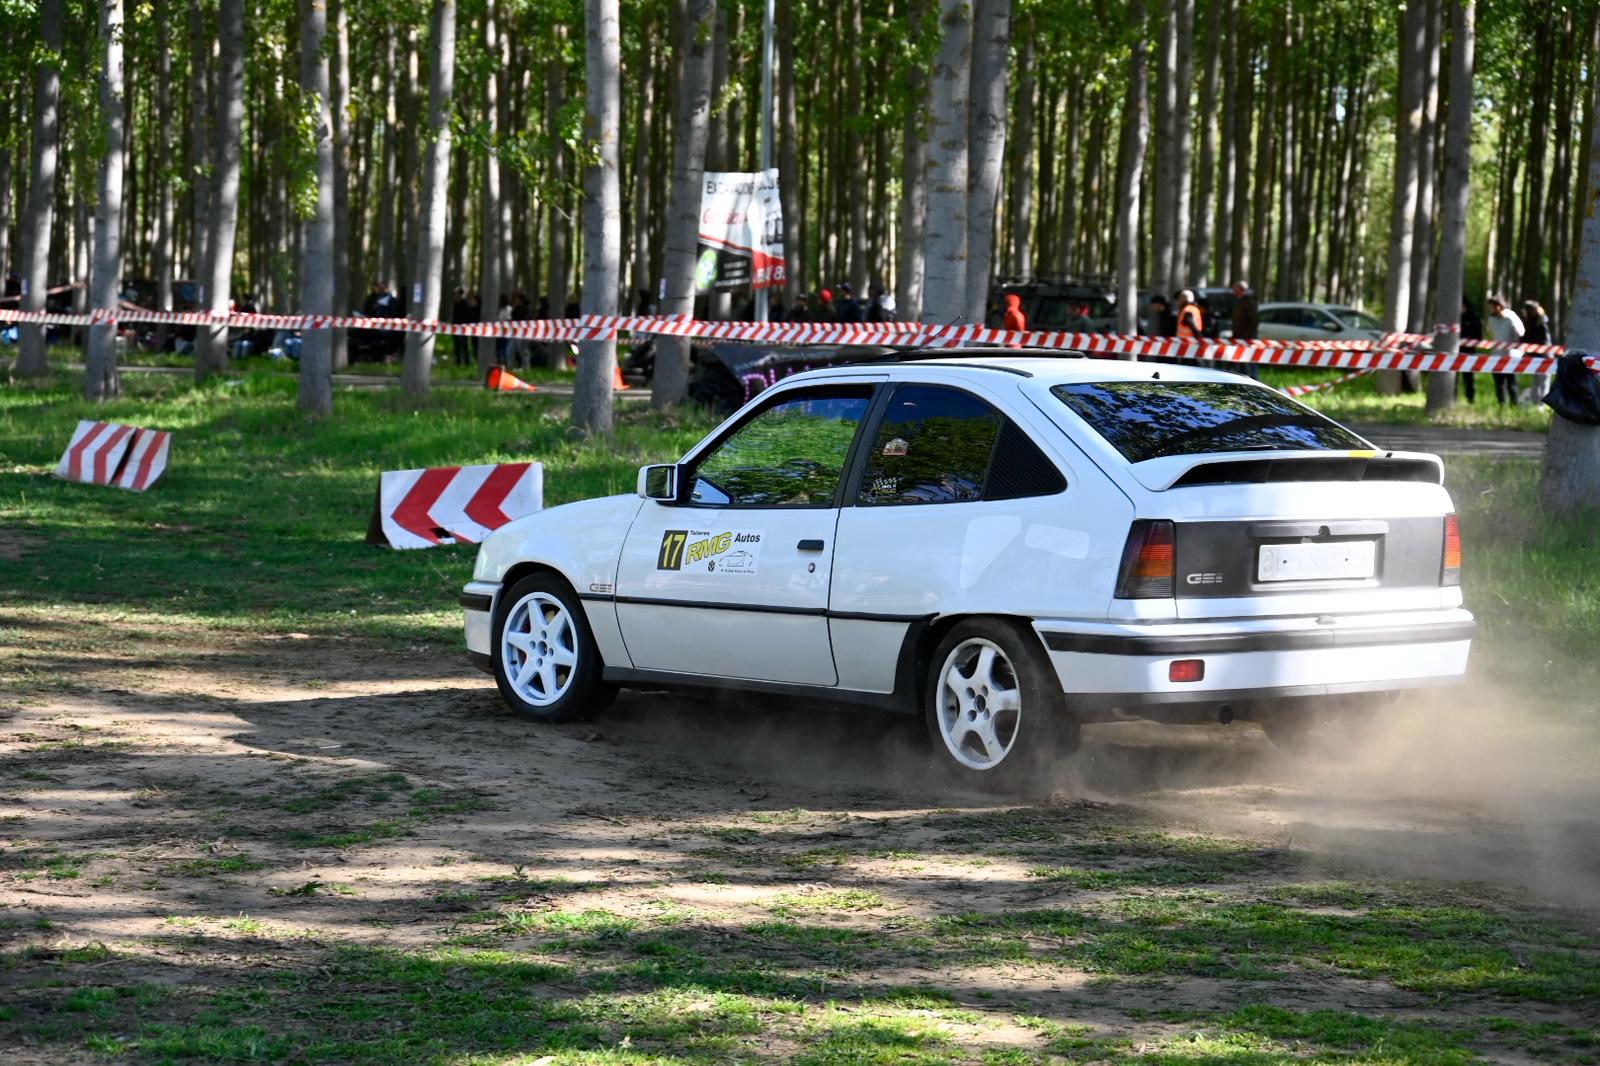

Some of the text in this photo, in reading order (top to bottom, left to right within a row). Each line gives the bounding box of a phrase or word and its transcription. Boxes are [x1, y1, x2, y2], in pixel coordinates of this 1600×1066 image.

[663, 533, 686, 568] 17
[685, 531, 761, 565] RMG Autos
